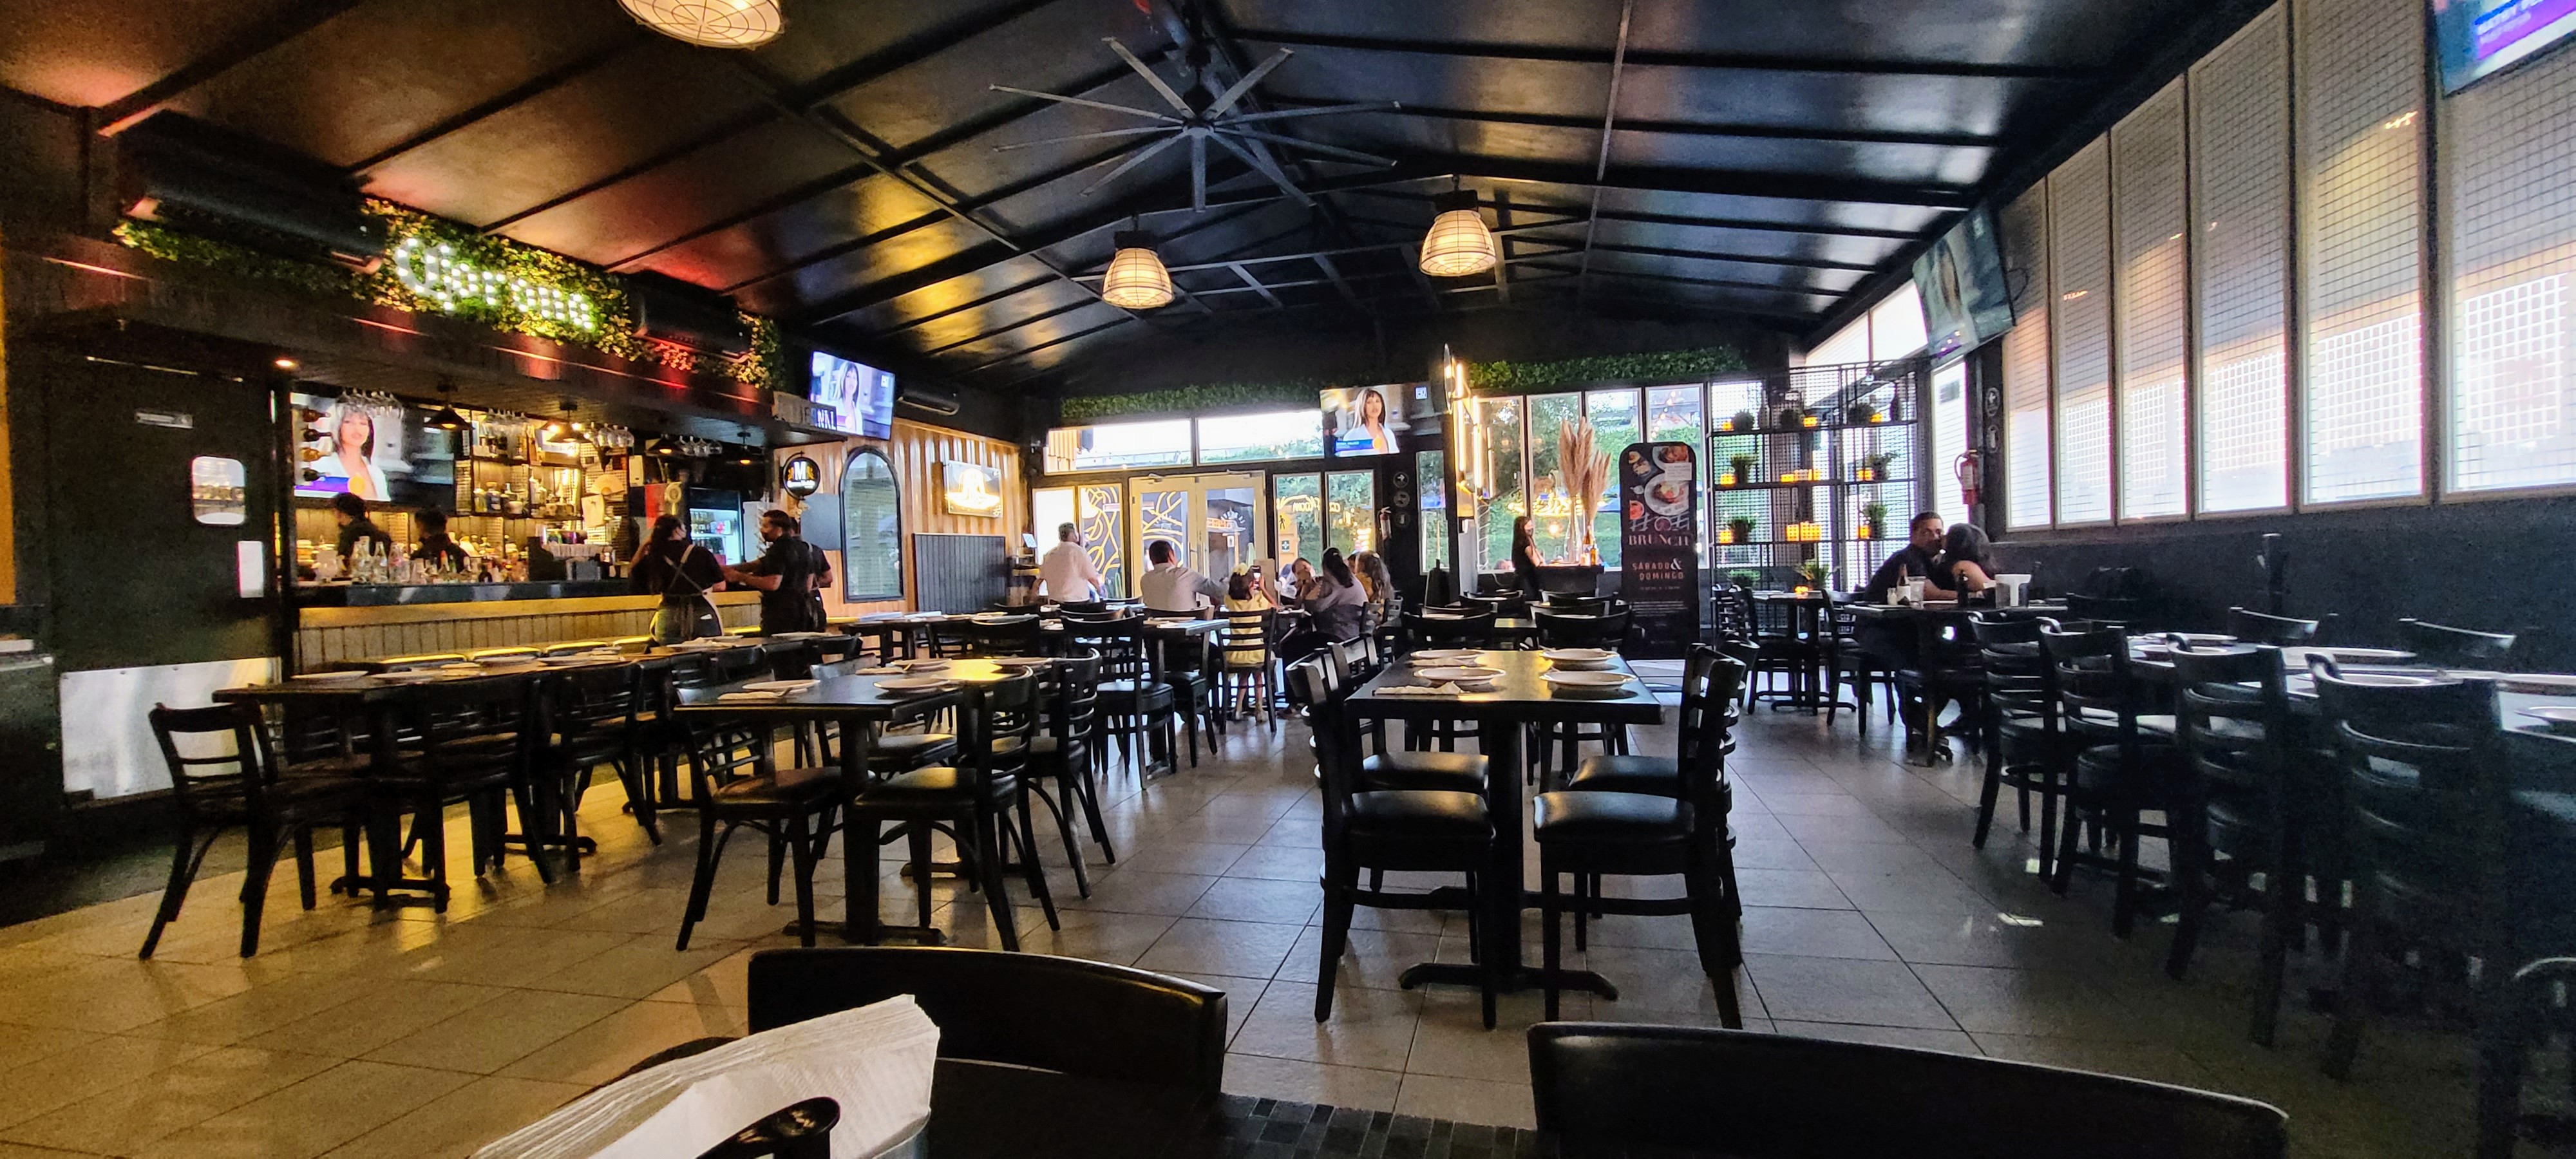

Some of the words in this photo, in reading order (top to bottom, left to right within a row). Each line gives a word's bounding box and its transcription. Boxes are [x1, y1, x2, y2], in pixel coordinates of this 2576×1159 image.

[1629, 534, 1689, 547] BRUNCH
[1670, 558, 1682, 570] &
[1639, 572, 1684, 581] DOMINGO
